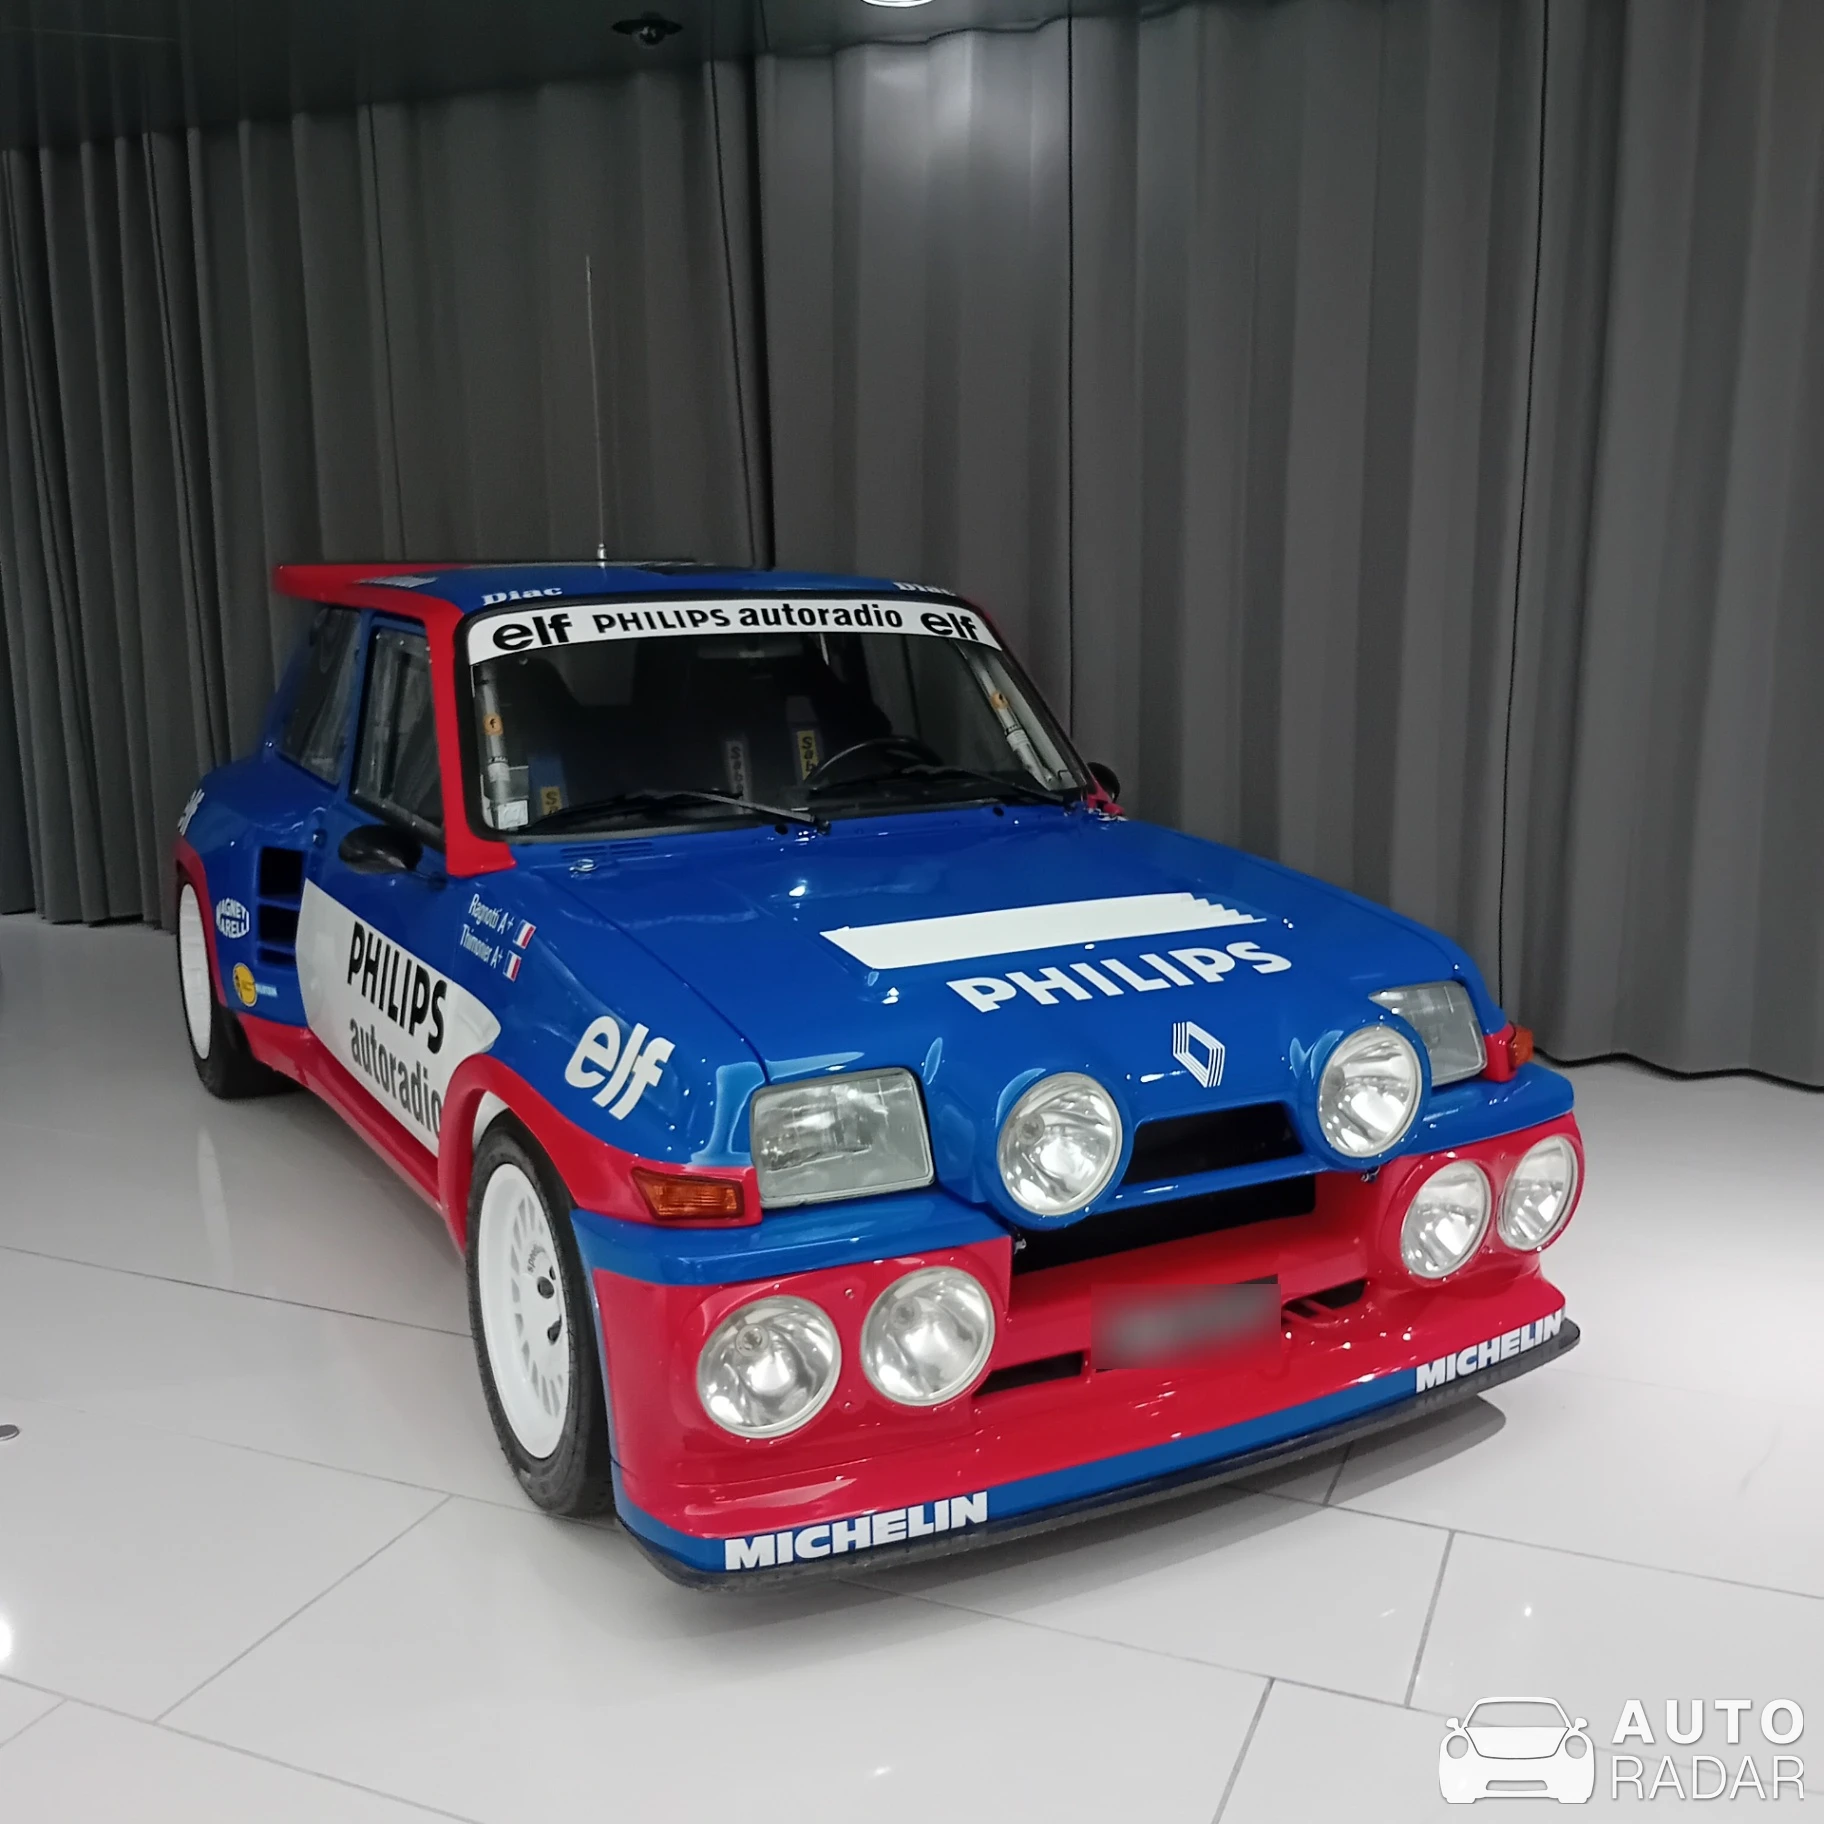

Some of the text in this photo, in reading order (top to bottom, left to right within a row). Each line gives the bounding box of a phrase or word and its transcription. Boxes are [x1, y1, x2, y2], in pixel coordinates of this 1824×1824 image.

[482, 587, 563, 606] Diac
[492, 603, 979, 651] elf PHILIPS autoradio elf
[347, 921, 448, 1055] PHILIPS
[946, 941, 1292, 1013] PHILIPS
[349, 1018, 441, 1138] autoradio
[564, 1015, 676, 1120] elf
[1416, 1309, 1562, 1394] MICHELIN
[725, 1491, 988, 1571] MICHELIN
